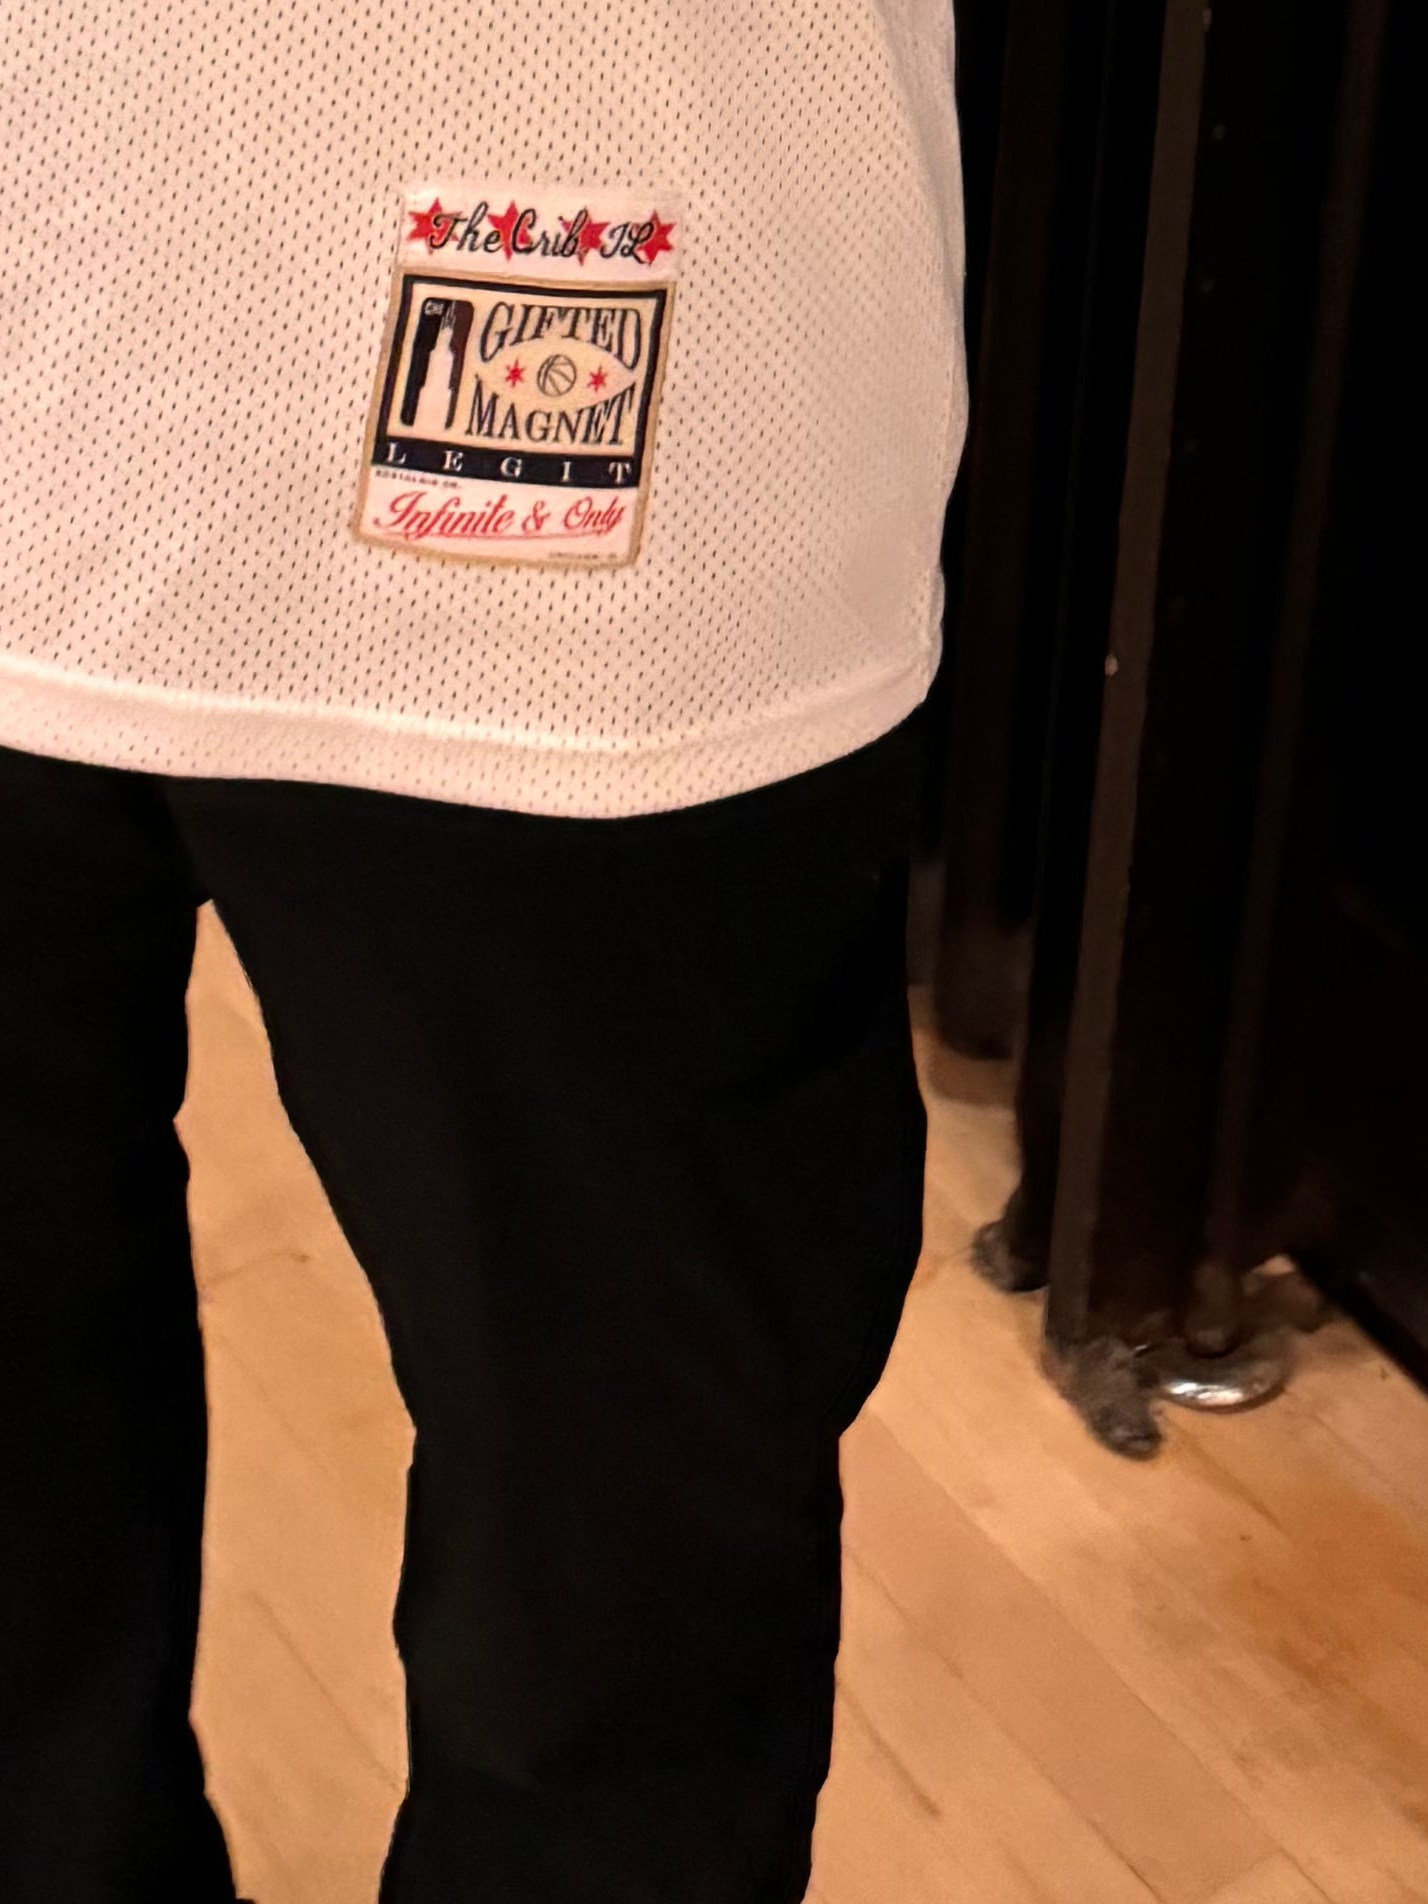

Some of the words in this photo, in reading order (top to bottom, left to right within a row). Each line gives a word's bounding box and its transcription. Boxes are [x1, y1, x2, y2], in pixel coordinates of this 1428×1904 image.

[429, 200, 502, 254] The
[511, 206, 588, 259] Crib
[600, 222, 656, 265] IL
[479, 301, 642, 370] GIFTED
[465, 374, 637, 446] MAGNET
[386, 442, 632, 485] LEGIT
[374, 491, 516, 540] Infinite
[522, 499, 551, 536] &
[563, 495, 626, 536] Only
